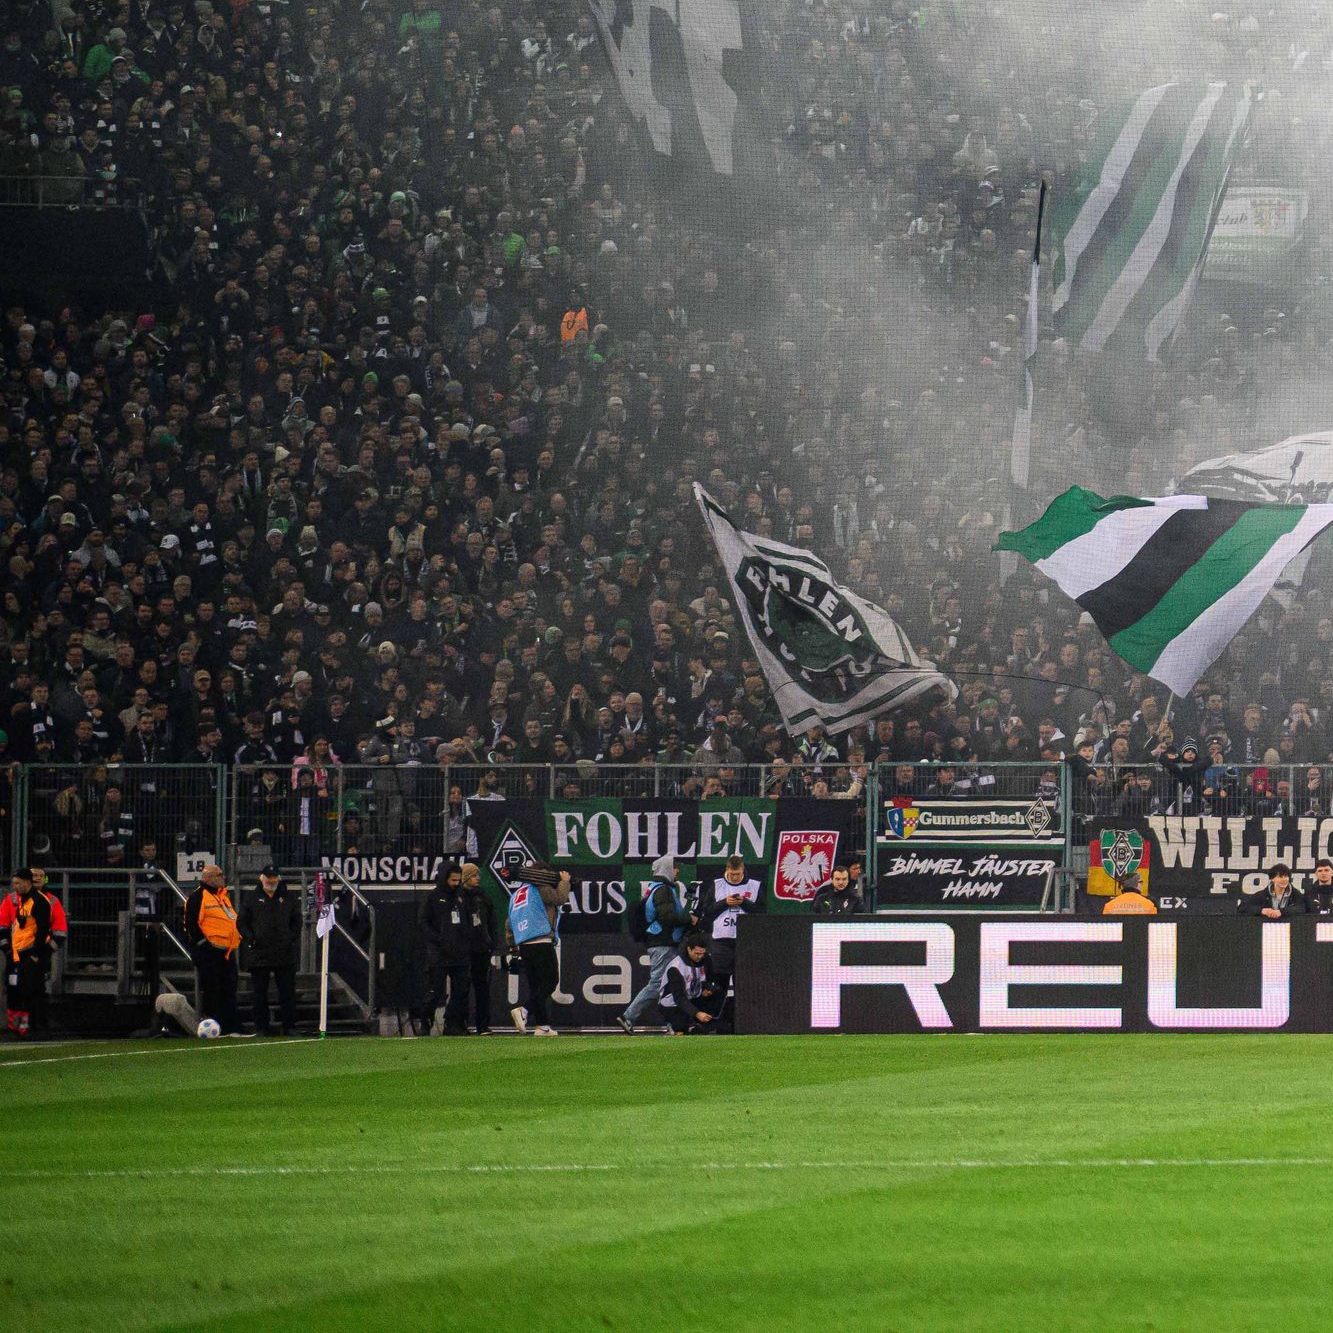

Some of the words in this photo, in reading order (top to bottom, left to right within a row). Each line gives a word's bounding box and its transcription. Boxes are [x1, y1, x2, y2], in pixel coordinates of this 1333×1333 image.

[919, 811, 1026, 829] Gummersbach
[552, 810, 773, 860] FOHLEN
[782, 832, 835, 845] POLSKA
[943, 879, 1003, 901] HAMM
